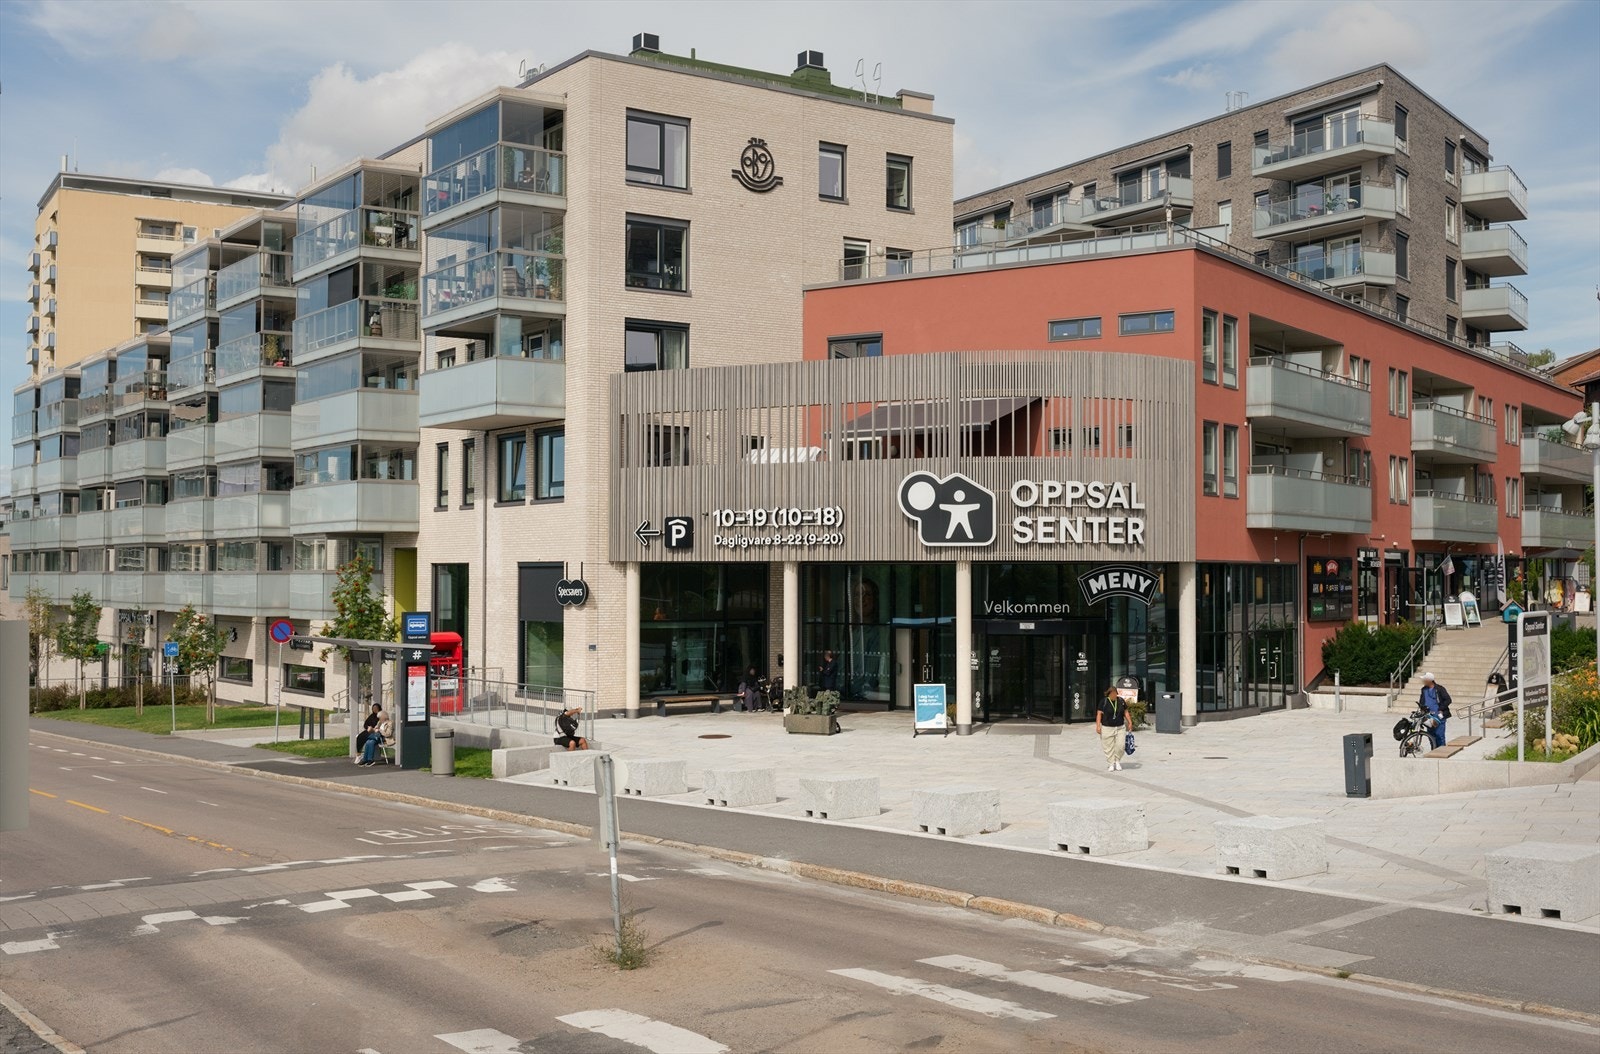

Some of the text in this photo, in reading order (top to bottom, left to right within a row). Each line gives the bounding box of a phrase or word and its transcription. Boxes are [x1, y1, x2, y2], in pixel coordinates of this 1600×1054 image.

[1010, 479, 1145, 510] OPPSAL
[713, 506, 844, 528] 10-19 (10-18)
[671, 525, 686, 546] P
[714, 533, 844, 548] Dagligvare 8-22 (9-20)
[1012, 516, 1144, 544] SENTER
[1088, 572, 1152, 594] MENY
[983, 600, 1070, 614] Velkommen
[364, 824, 523, 839] BUSS
